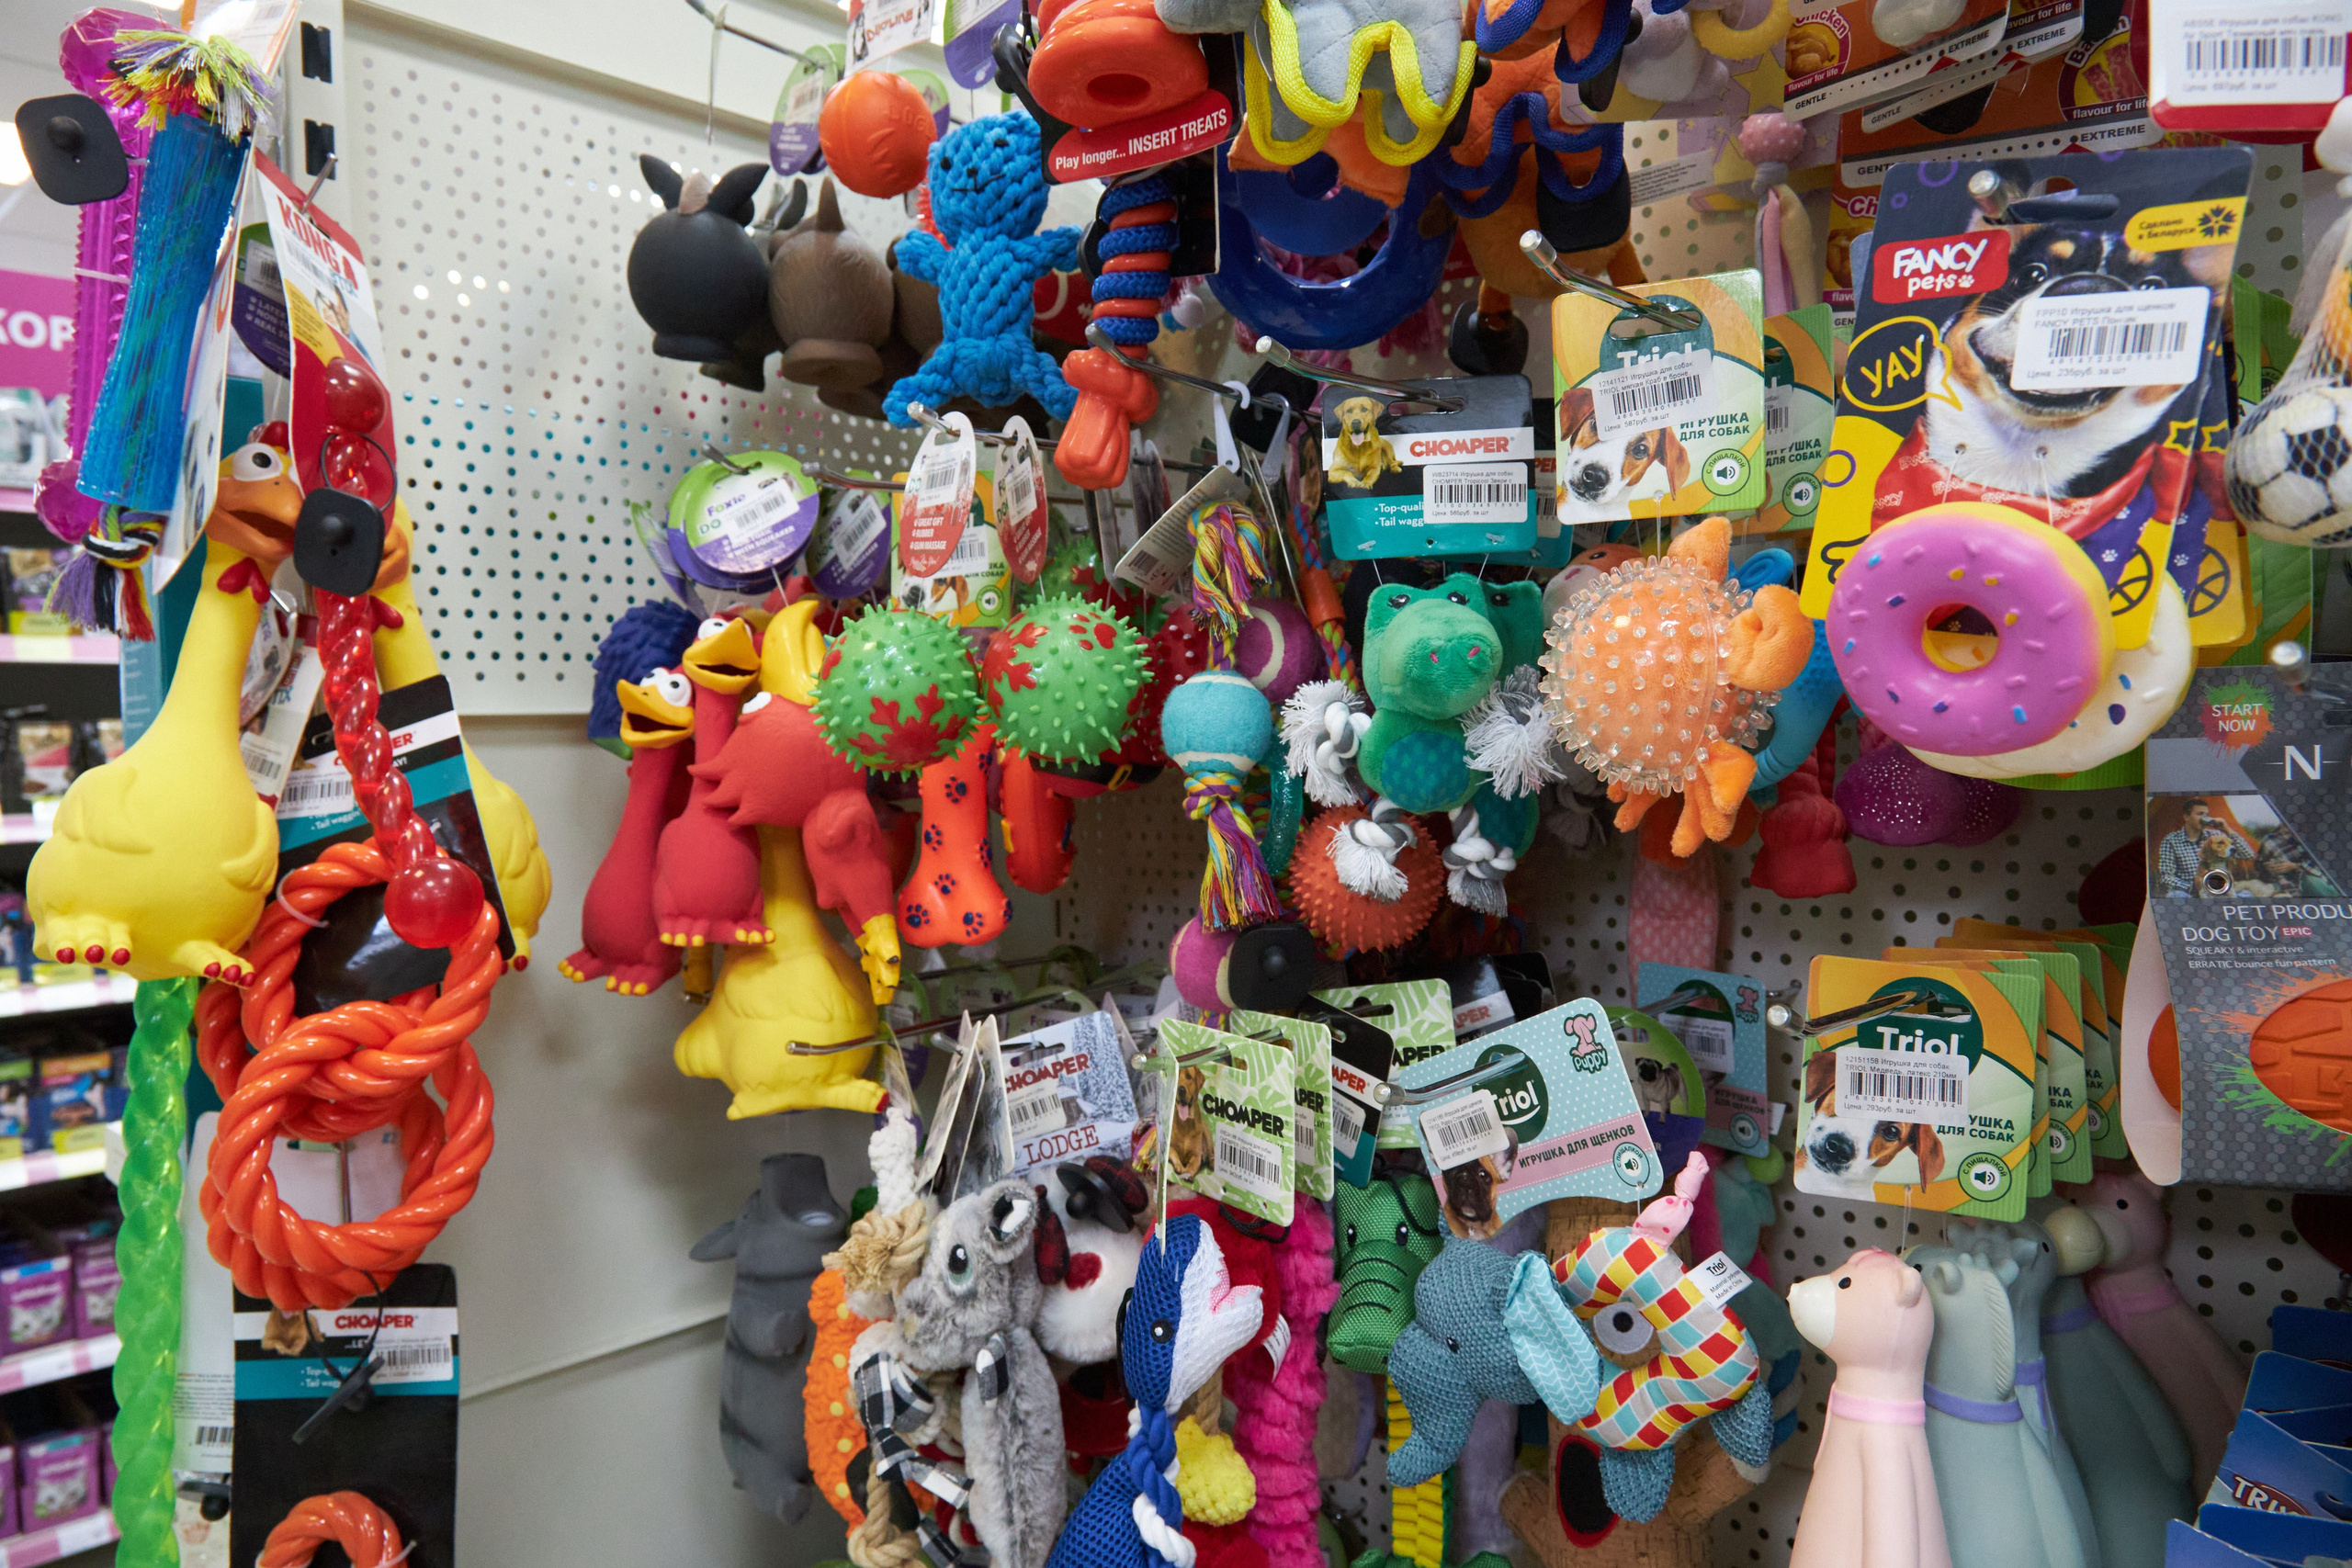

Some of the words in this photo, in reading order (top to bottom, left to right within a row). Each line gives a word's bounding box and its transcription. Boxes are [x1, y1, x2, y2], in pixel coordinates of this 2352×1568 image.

[2007, 15, 2035, 28] avour
[2038, 8, 2053, 19] for
[2055, 2, 2072, 15] life
[1948, 29, 1991, 54] EXTREME
[2017, 27, 2066, 49] EXTREME
[1788, 78, 1813, 92] flavour
[1826, 69, 1838, 77] life
[1795, 92, 1827, 110] GENTLE
[1871, 105, 1903, 124] GENTLE
[2073, 105, 2113, 118] flavour
[2116, 102, 2132, 113] for
[1056, 156, 1079, 170] Play
[1082, 148, 1126, 164] longer...
[1128, 127, 1177, 155] INSERT
[1180, 107, 1227, 139] TREATS
[2080, 124, 2146, 143] EXTREME
[2140, 218, 2185, 230] Сделано
[2148, 224, 2197, 240] Беларуси
[277, 195, 340, 274] KONG
[1893, 238, 1988, 279] FANCY
[1907, 273, 1957, 298] pets
[2070, 306, 2111, 316] Игрушка
[2114, 304, 2134, 314] для
[2034, 319, 2070, 329] FANCY
[2072, 317, 2100, 327] PETS
[1599, 376, 1629, 388] 12141121
[1630, 367, 1658, 380] Игрушка
[1659, 365, 1673, 375] для
[1674, 361, 1693, 371] собак
[1600, 387, 1621, 396] TRIOL
[1645, 377, 1662, 388] Краб
[1679, 431, 1705, 442] ДЛЯ
[1708, 426, 1750, 438] СОБАК
[1409, 435, 1510, 457] CHOMPER
[1708, 453, 1746, 470] ПИЩАЛКОЙ
[1788, 449, 1822, 464] СОБАК
[1379, 502, 1424, 513] Top-quali
[1379, 518, 1396, 527] Tail
[1398, 518, 1424, 527] wagg
[2211, 704, 2263, 717] START
[2218, 719, 2256, 732] NOW
[2222, 905, 2267, 920] PET
[2273, 904, 2352, 919] PRODU
[2182, 927, 2231, 942] DOG
[2233, 926, 2279, 942] TOY
[2282, 927, 2312, 937] EPIC
[2186, 946, 2234, 955] SQUEAKY
[2236, 946, 2245, 954] &
[2247, 945, 2304, 954] interactive
[2188, 960, 2233, 969] ERRATIC
[2233, 960, 2273, 969] bounce
[2275, 959, 2294, 967] fun
[2294, 957, 2336, 968] pattern
[1876, 1026, 1962, 1055] Triol
[1574, 1050, 1608, 1074] Puppy
[1846, 1056, 1879, 1065] 12151158
[1881, 1057, 1911, 1068] Игрушка
[1913, 1061, 1928, 1069] для
[1929, 1061, 1951, 1071] собак
[1005, 1053, 1091, 1093] CHOMPER
[1846, 1064, 1868, 1072] TRIOL
[1906, 1069, 1931, 1077] латекс
[1933, 1070, 1957, 1079] 210мм
[1844, 1102, 1864, 1111] Цена:
[2050, 1099, 2074, 1109] БАК
[1203, 1093, 1284, 1138] CHOMPER
[1969, 1114, 2015, 1132] УШКА
[1937, 1124, 1964, 1137] ДЛЯ
[1969, 1126, 2015, 1144] СОБАК
[1023, 1124, 1100, 1166] LODGE
[1519, 1145, 1566, 1168] ИГРУШКА
[1567, 1139, 1589, 1156] ДЛЯ
[1590, 1125, 1635, 1149] ЩЕНКОВ
[1966, 1156, 2007, 1178] ПИЩАЛКОЙ
[1706, 1258, 1726, 1275] Triol
[1715, 1288, 1729, 1300] Made
[334, 1314, 414, 1329] CHOMPER
